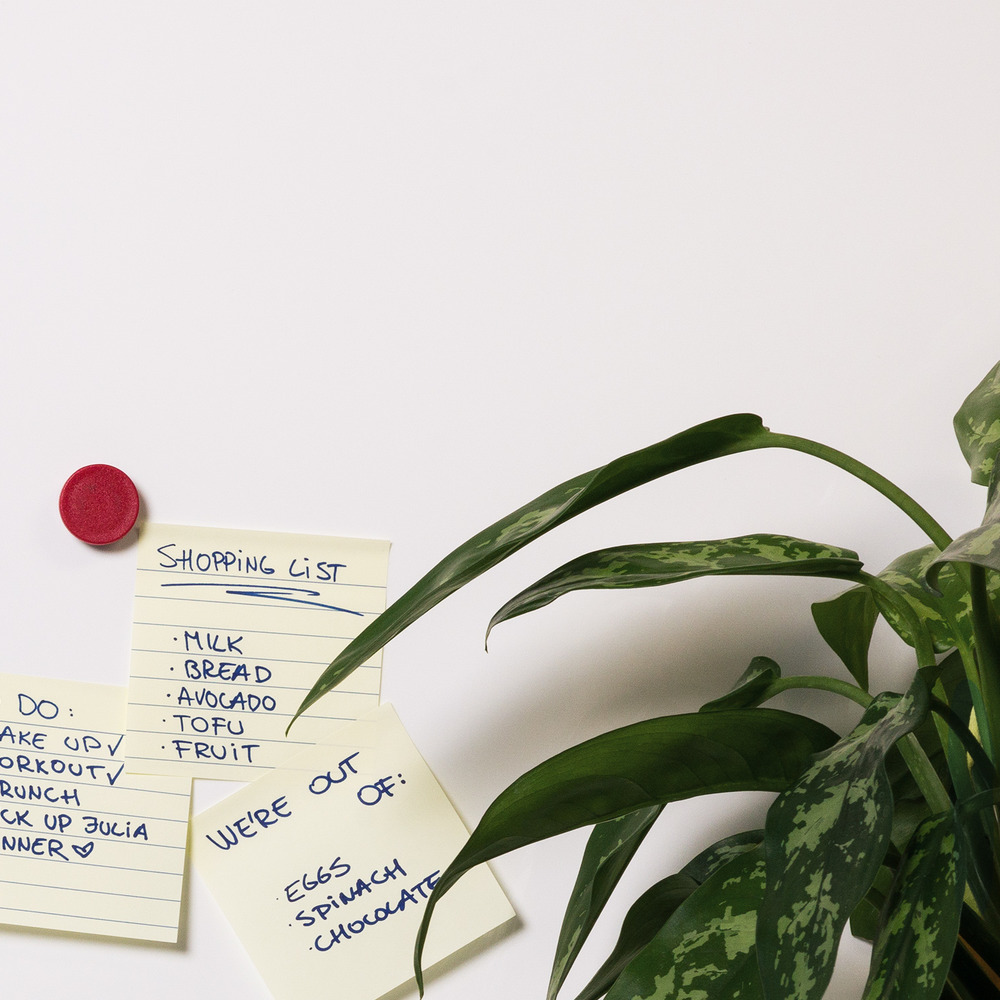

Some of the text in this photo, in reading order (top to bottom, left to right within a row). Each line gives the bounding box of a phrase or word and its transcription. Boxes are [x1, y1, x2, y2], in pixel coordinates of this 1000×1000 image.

[184, 630, 243, 655] MILK
[184, 659, 272, 684] BREAD
[177, 686, 277, 713] AVOCADO
[173, 714, 245, 736] TOFU
[63, 735, 102, 753] UP
[205, 751, 362, 852] WE'RE OUT
[43, 815, 73, 833] UP
[284, 856, 352, 904] EGGS
[313, 869, 442, 953] CHOCOLATE
